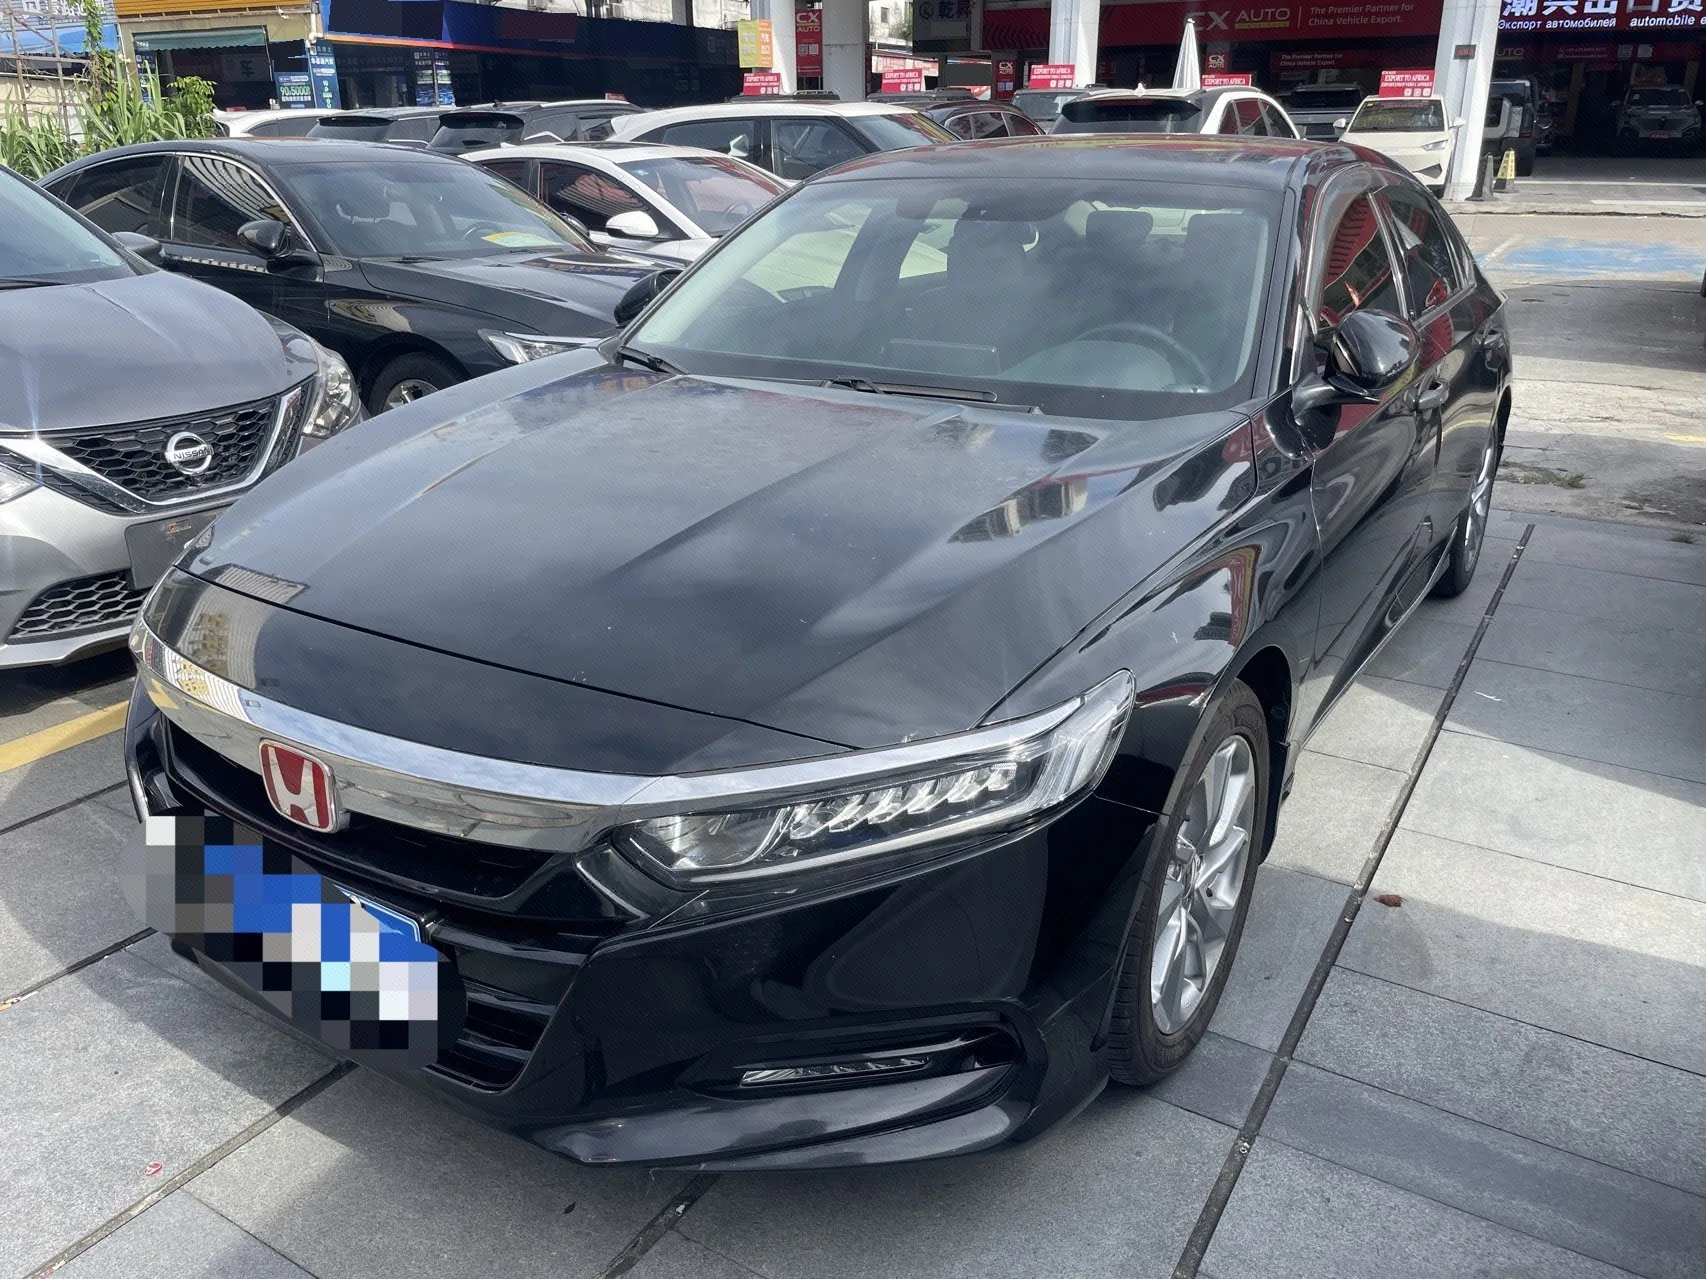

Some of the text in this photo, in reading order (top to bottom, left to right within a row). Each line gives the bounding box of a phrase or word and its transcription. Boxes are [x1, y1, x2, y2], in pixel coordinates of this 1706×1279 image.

[1310, 3, 1414, 15] The Premier Partner for
[796, 12, 819, 23] CX
[1235, 8, 1291, 23] AUTO
[1308, 15, 1404, 26] China Vehicle Export.
[1630, 14, 1696, 27] automobile
[1498, 17, 1617, 30] Экспорт автомобилей
[1496, 47, 1525, 57] UTO
[1208, 54, 1225, 62] CX
[999, 61, 1013, 69] CX
[1384, 74, 1404, 82] EXPORT
[173, 444, 213, 461] NISSAN
